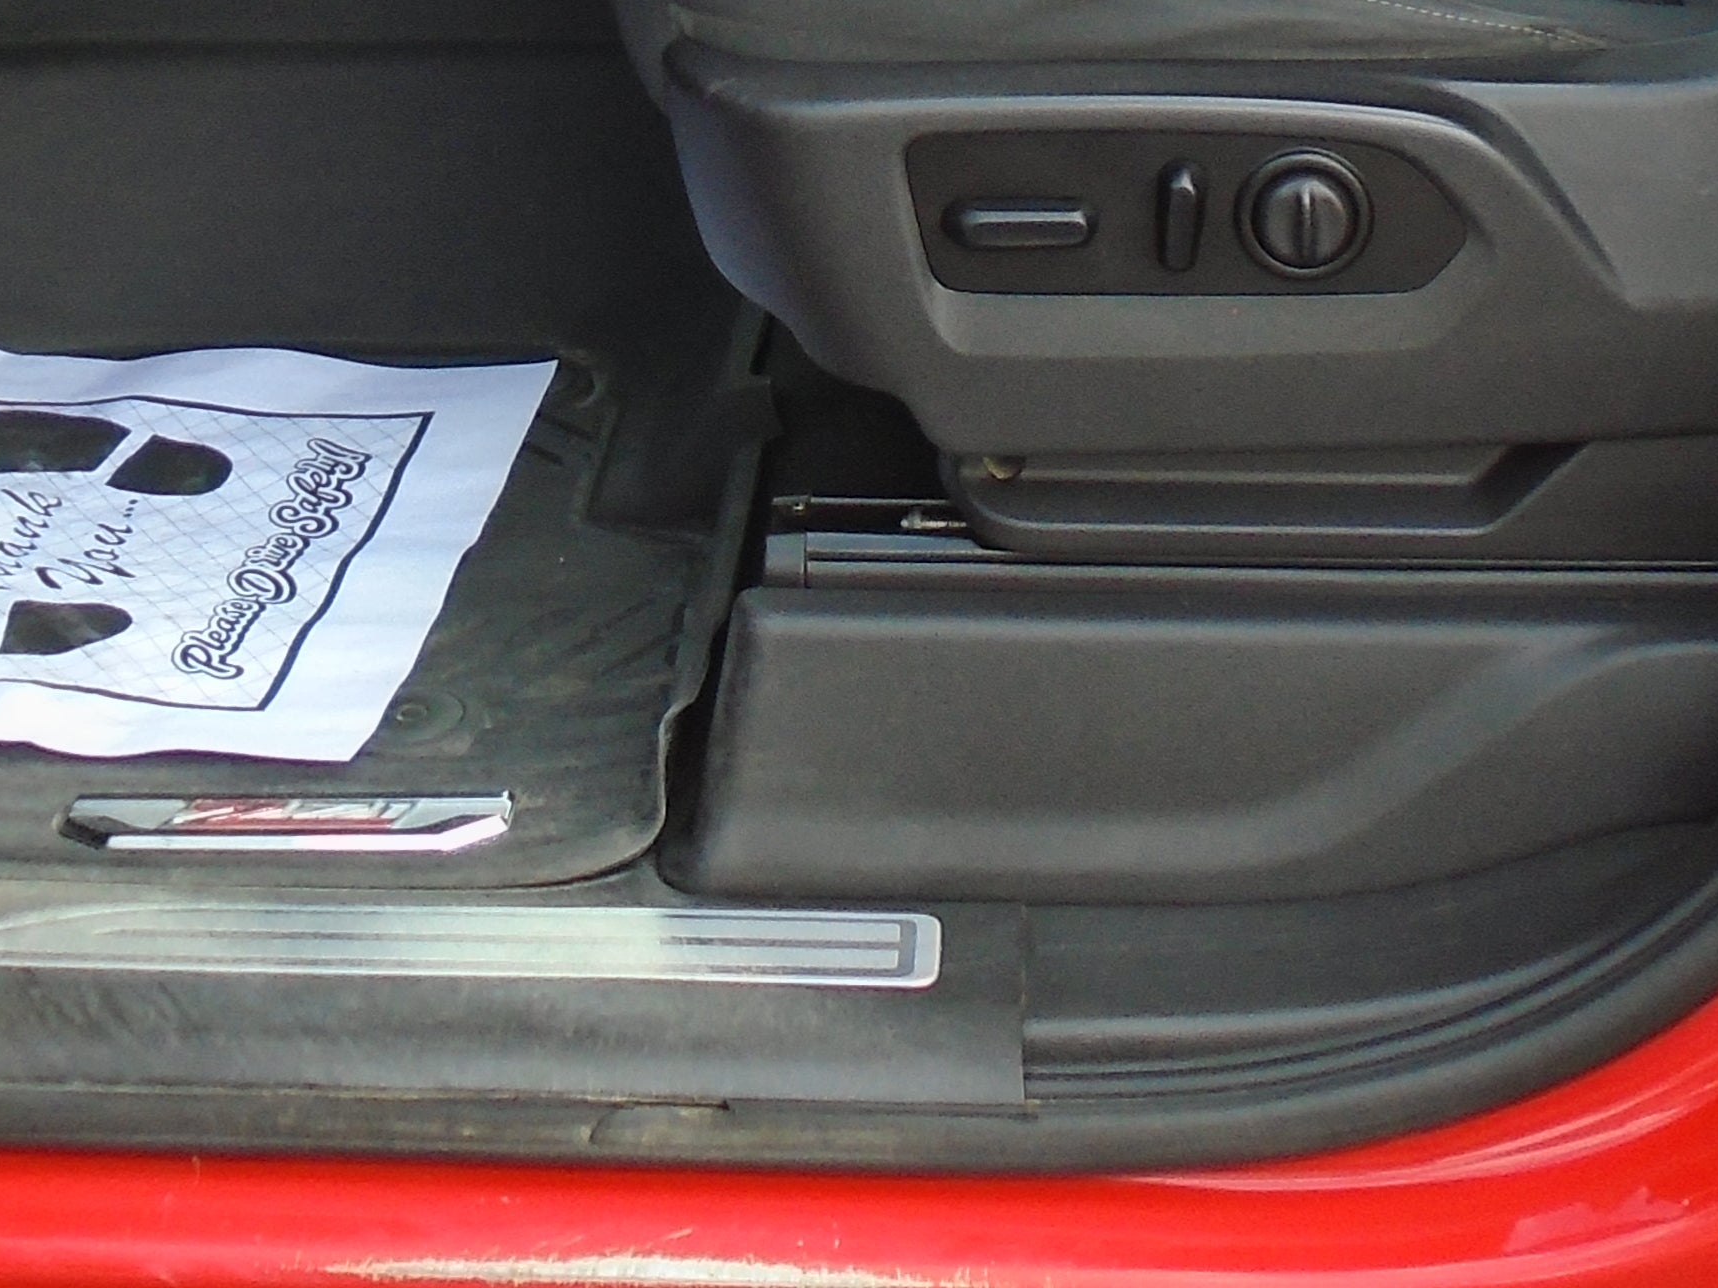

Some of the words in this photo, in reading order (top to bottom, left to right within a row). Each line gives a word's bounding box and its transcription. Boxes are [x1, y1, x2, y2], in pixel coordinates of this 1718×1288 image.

[172, 598, 266, 680] Please
[227, 532, 311, 604] Drive
[269, 438, 372, 539] Safely!
